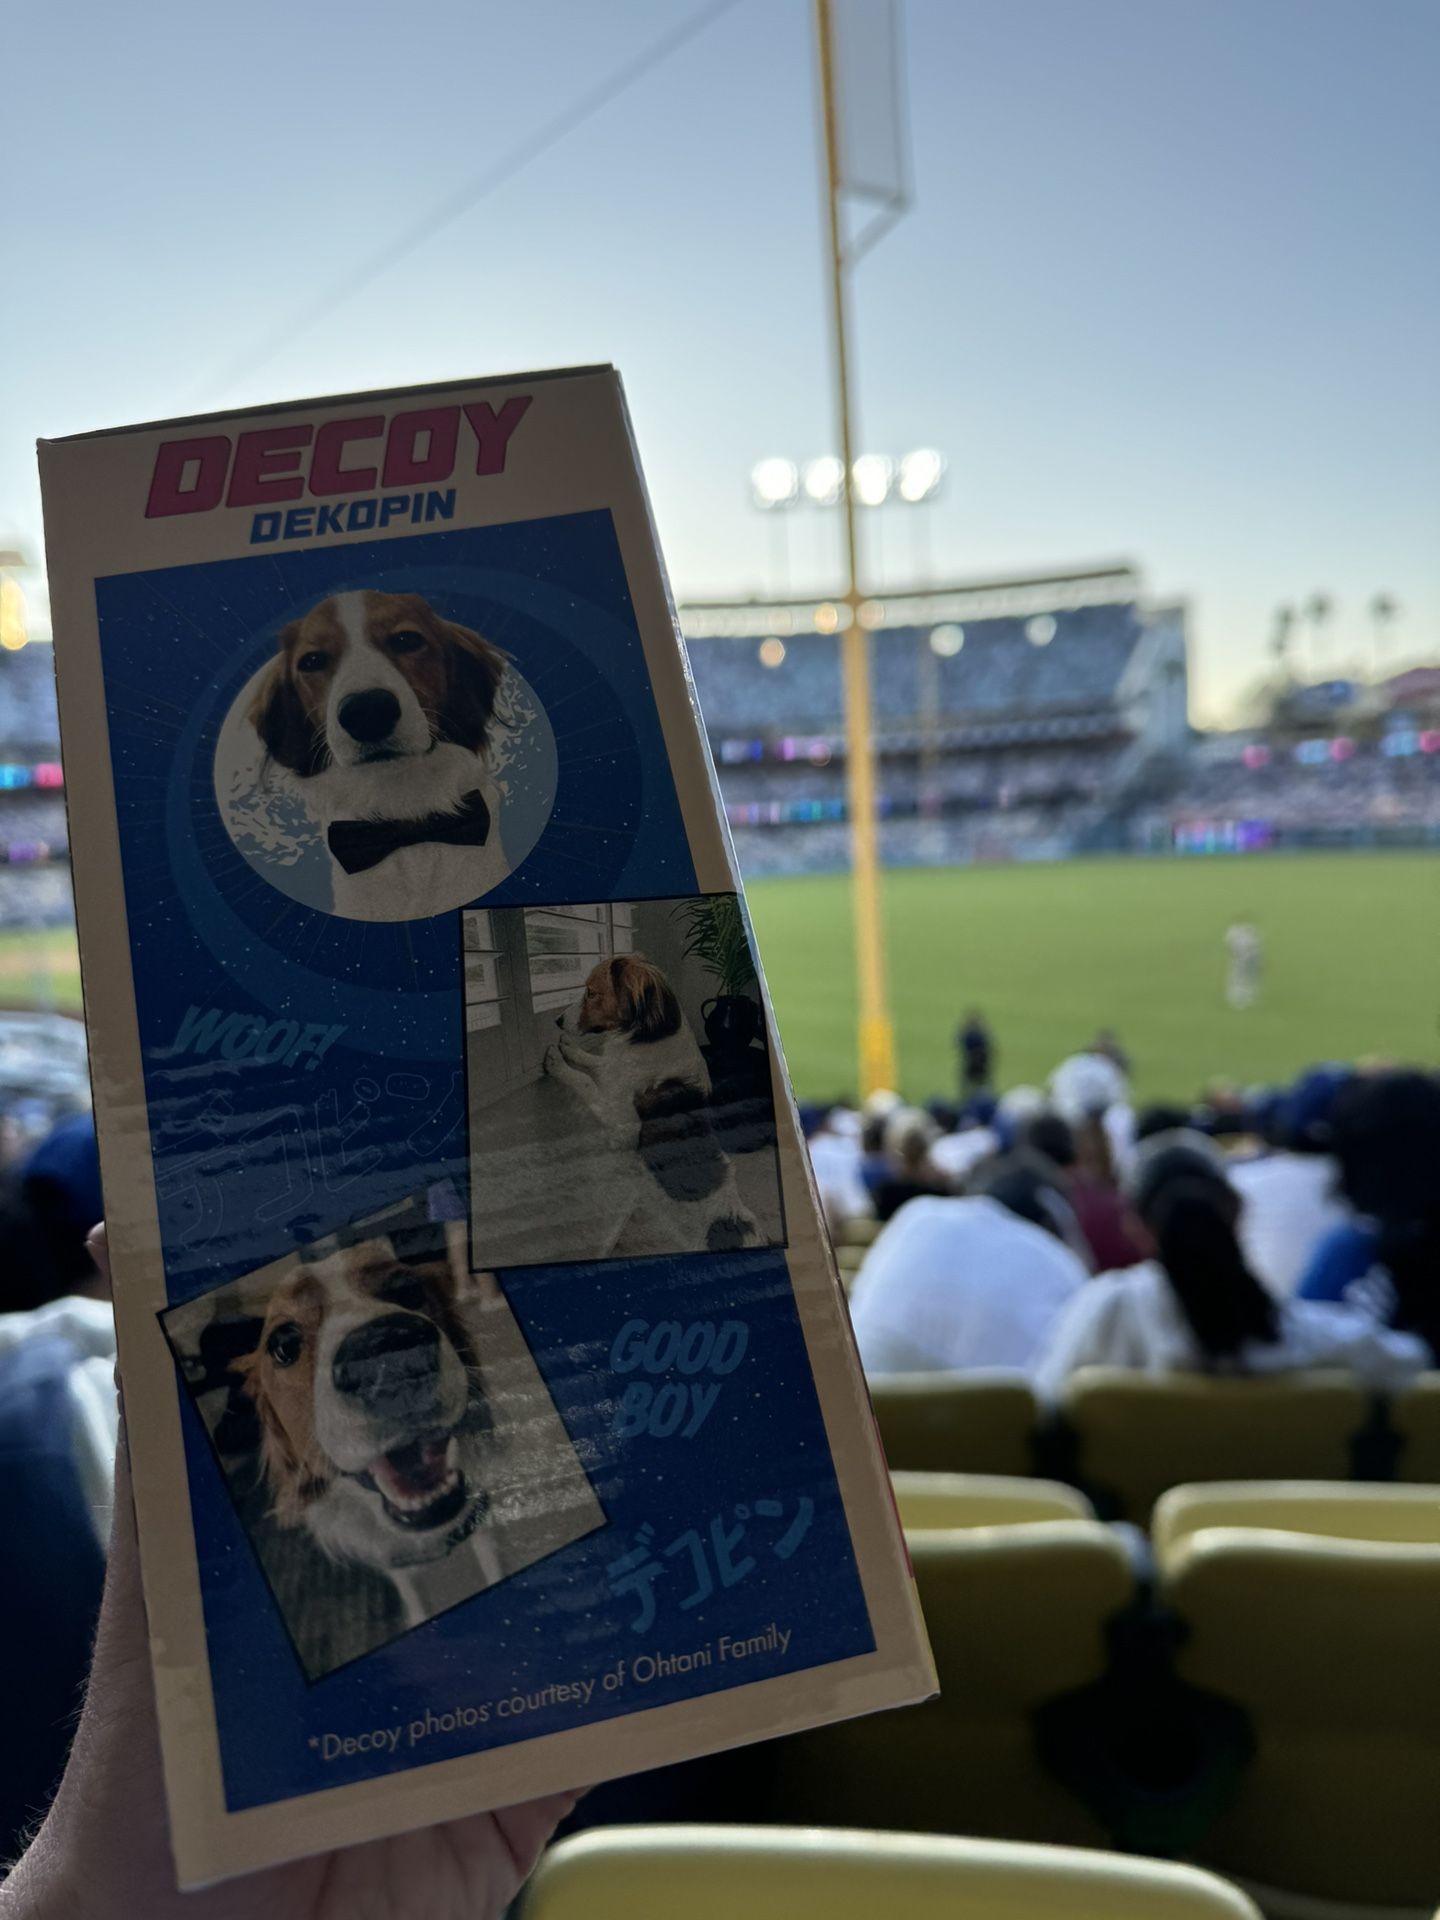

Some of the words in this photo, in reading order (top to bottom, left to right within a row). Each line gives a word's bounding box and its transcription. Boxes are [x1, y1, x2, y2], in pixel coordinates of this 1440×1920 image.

[145, 395, 533, 519] DECOY
[250, 488, 457, 545] DEKOPIN
[173, 1004, 349, 1071] WOOF!
[609, 1318, 750, 1376] GOOD
[612, 1381, 722, 1440] BOY
[605, 1495, 815, 1634] デコピン
[408, 1707, 490, 1748] photos
[496, 1678, 596, 1718] courtesy
[602, 1659, 628, 1692] of
[632, 1642, 712, 1683] Ohtani
[718, 1621, 792, 1662] Family
